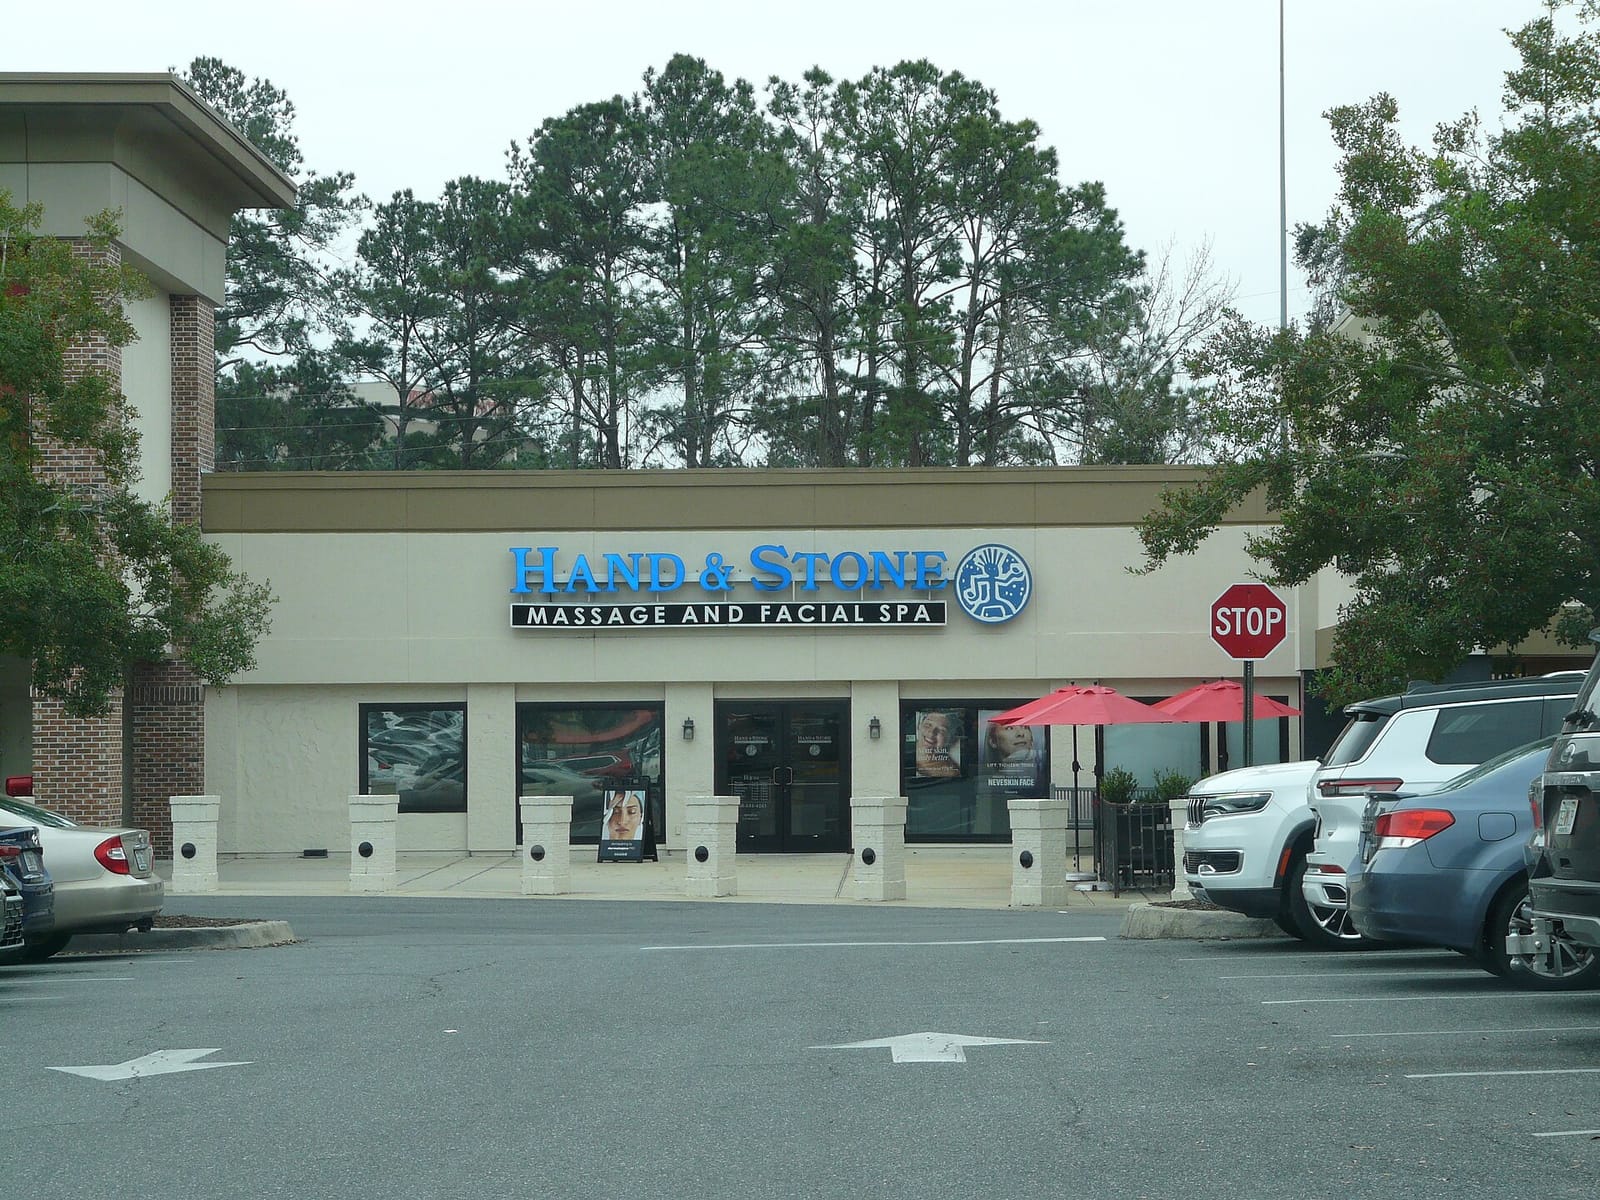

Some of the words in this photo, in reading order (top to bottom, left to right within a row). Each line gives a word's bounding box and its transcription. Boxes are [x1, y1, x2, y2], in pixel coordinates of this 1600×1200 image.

[509, 547, 685, 593] HAND
[699, 552, 734, 591] &
[750, 545, 949, 592] STONE
[527, 606, 665, 624] MASSAGE
[682, 605, 744, 623] AND
[760, 604, 864, 622] FACIAL
[879, 604, 930, 622] SPA
[1215, 607, 1282, 636] STOP
